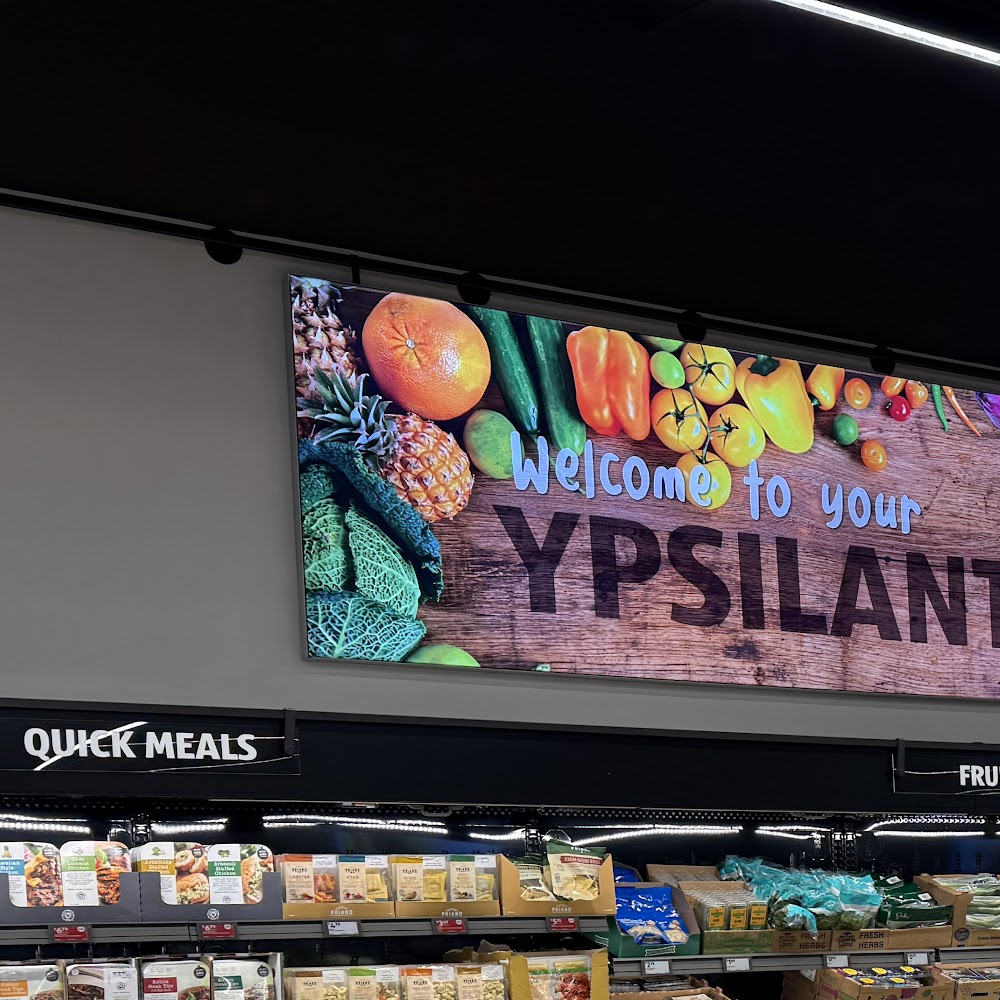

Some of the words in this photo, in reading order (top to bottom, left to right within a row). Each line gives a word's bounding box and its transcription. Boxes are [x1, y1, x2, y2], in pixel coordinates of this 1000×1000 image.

[510, 431, 713, 509] Welcome
[744, 459, 792, 521] to
[822, 481, 922, 535] your
[23, 727, 138, 762] QUICK
[145, 730, 258, 761] MEALS
[860, 932, 884, 940] FRESH
[799, 941, 826, 949] HERBS
[859, 940, 884, 949] HERBS
